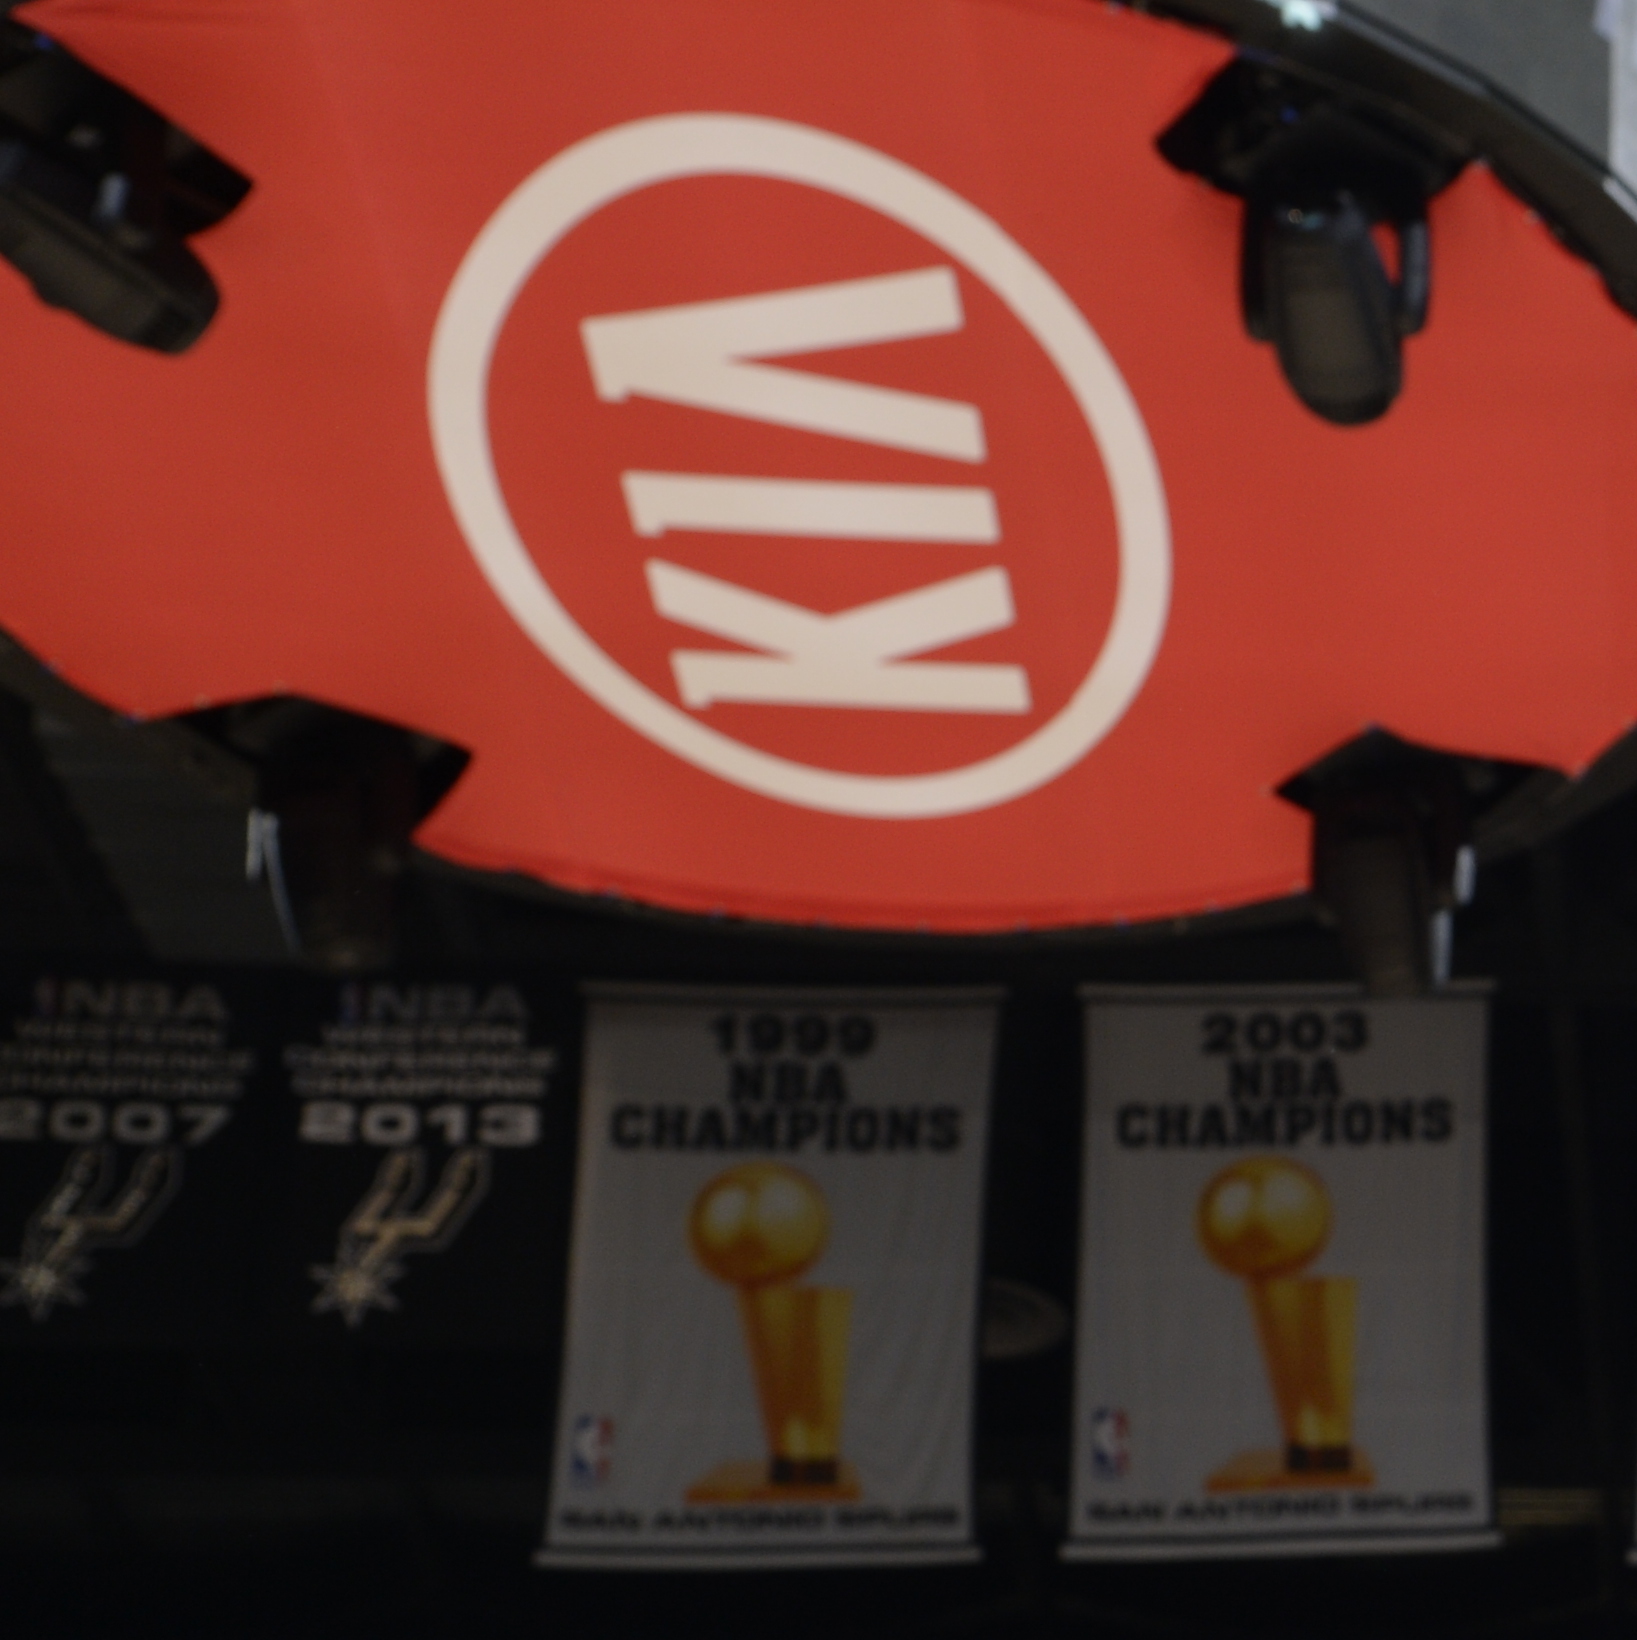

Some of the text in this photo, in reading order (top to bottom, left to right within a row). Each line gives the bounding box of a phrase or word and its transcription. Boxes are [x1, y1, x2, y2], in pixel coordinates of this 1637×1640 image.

[581, 266, 1030, 714] KIA
[60, 980, 230, 1019] NBA
[366, 983, 533, 1022] NBA
[712, 1013, 874, 1055] 1999
[1202, 1012, 1367, 1054] 2003
[729, 1061, 846, 1104] NBA
[1228, 1058, 1341, 1100] NBA
[0, 1099, 235, 1146] 2007
[296, 1100, 543, 1147] 2013
[610, 1105, 961, 1153] CHAMPIONS
[1116, 1099, 1452, 1148] CHAMPIONS
